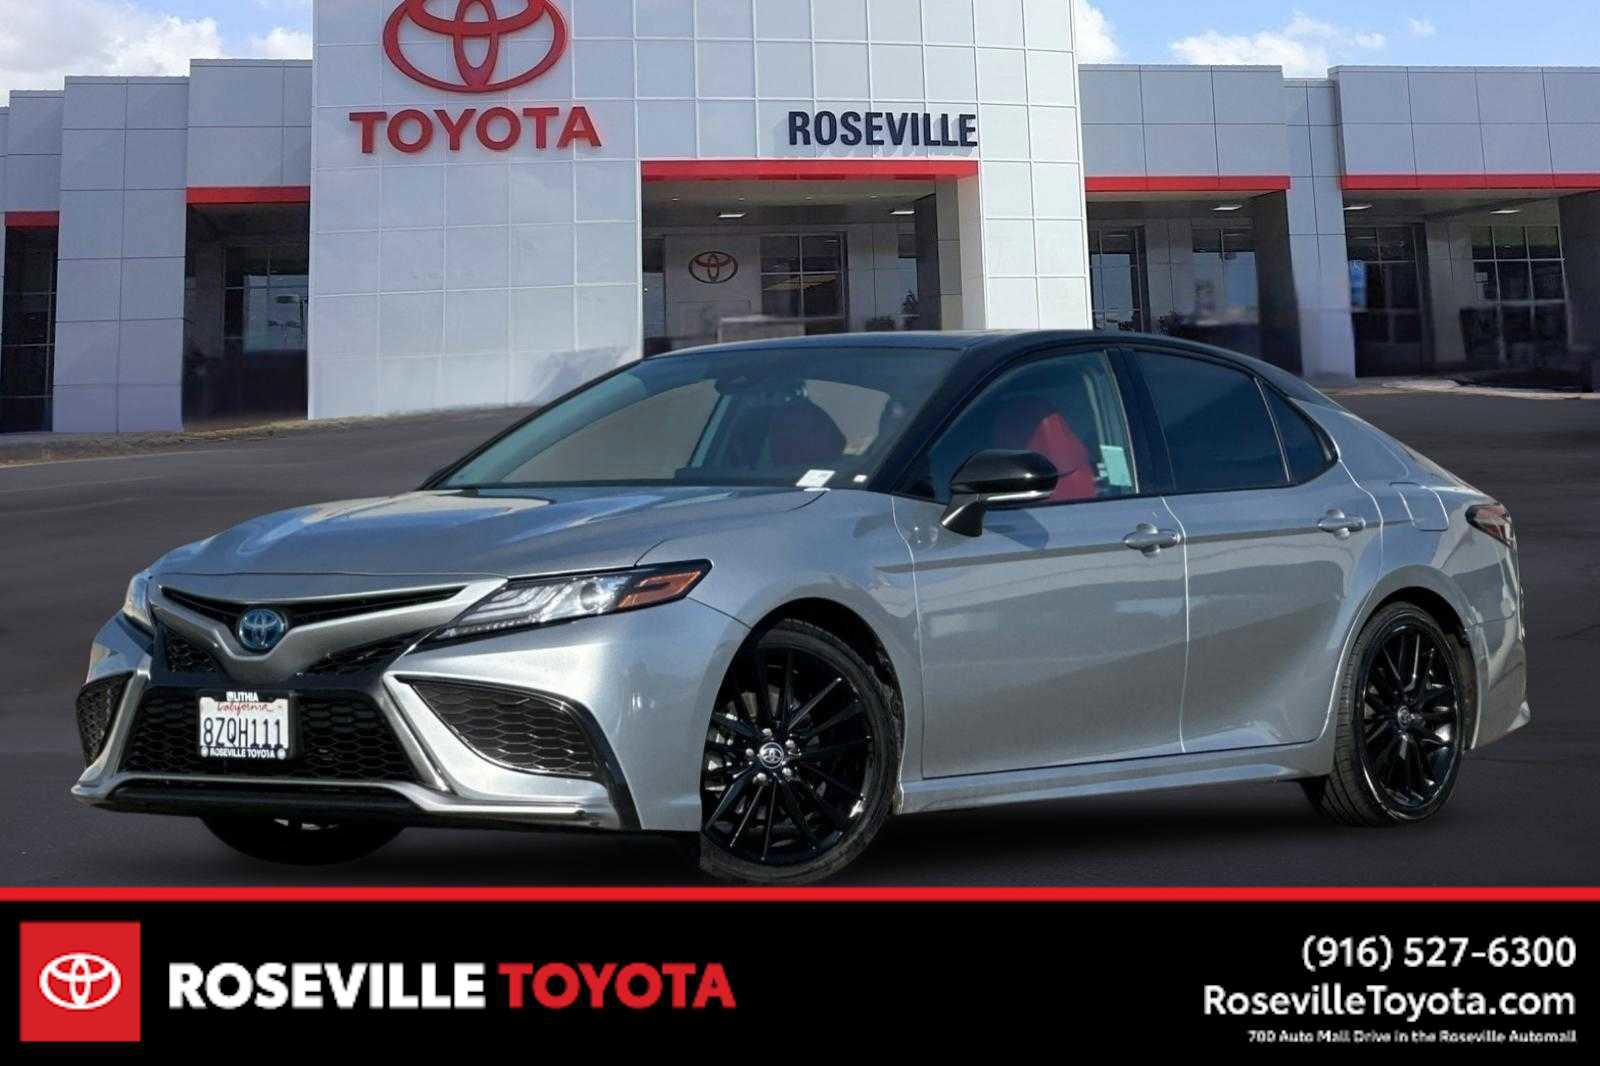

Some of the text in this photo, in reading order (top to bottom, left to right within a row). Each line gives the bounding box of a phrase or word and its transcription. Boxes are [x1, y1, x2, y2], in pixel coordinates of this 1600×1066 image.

[349, 106, 602, 153] TOYOTA
[788, 110, 979, 148] ROSEVILLE
[203, 717, 284, 749] 8ZQH111
[209, 747, 276, 759] ROSEVILLE TOYOTA
